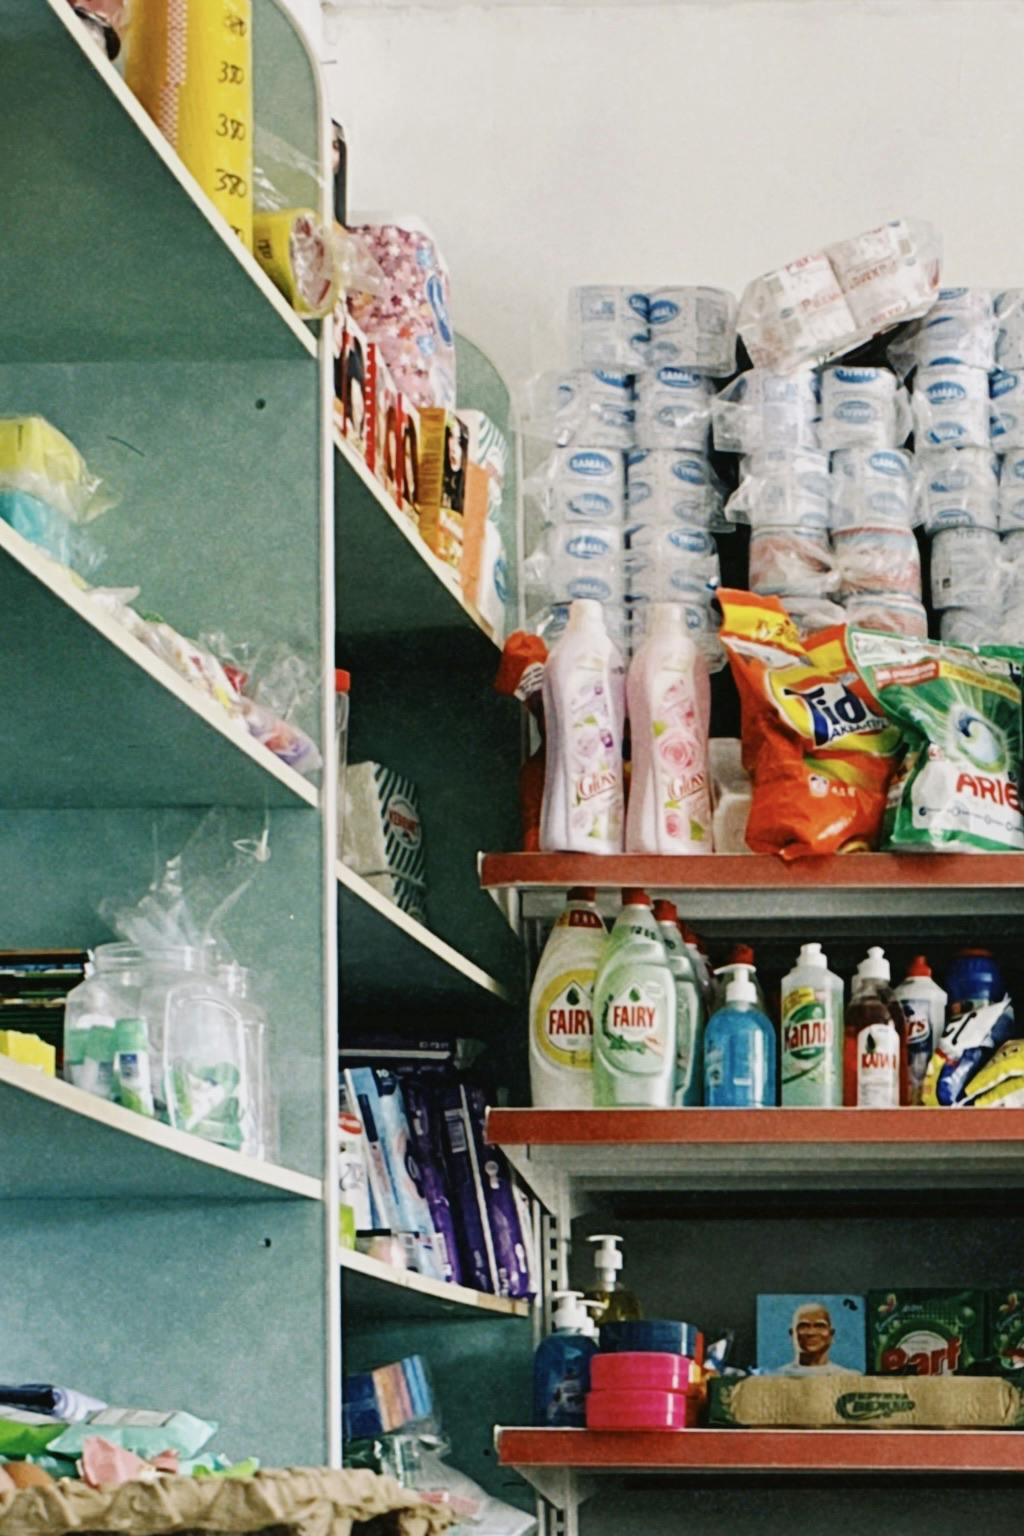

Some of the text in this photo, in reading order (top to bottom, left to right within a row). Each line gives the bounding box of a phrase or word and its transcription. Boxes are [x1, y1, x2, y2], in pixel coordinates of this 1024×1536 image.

[571, 458, 605, 469] SAMAL
[956, 772, 1022, 813] ARIE
[549, 1009, 595, 1036] FAIRY
[613, 1005, 657, 1029] FAIRY
